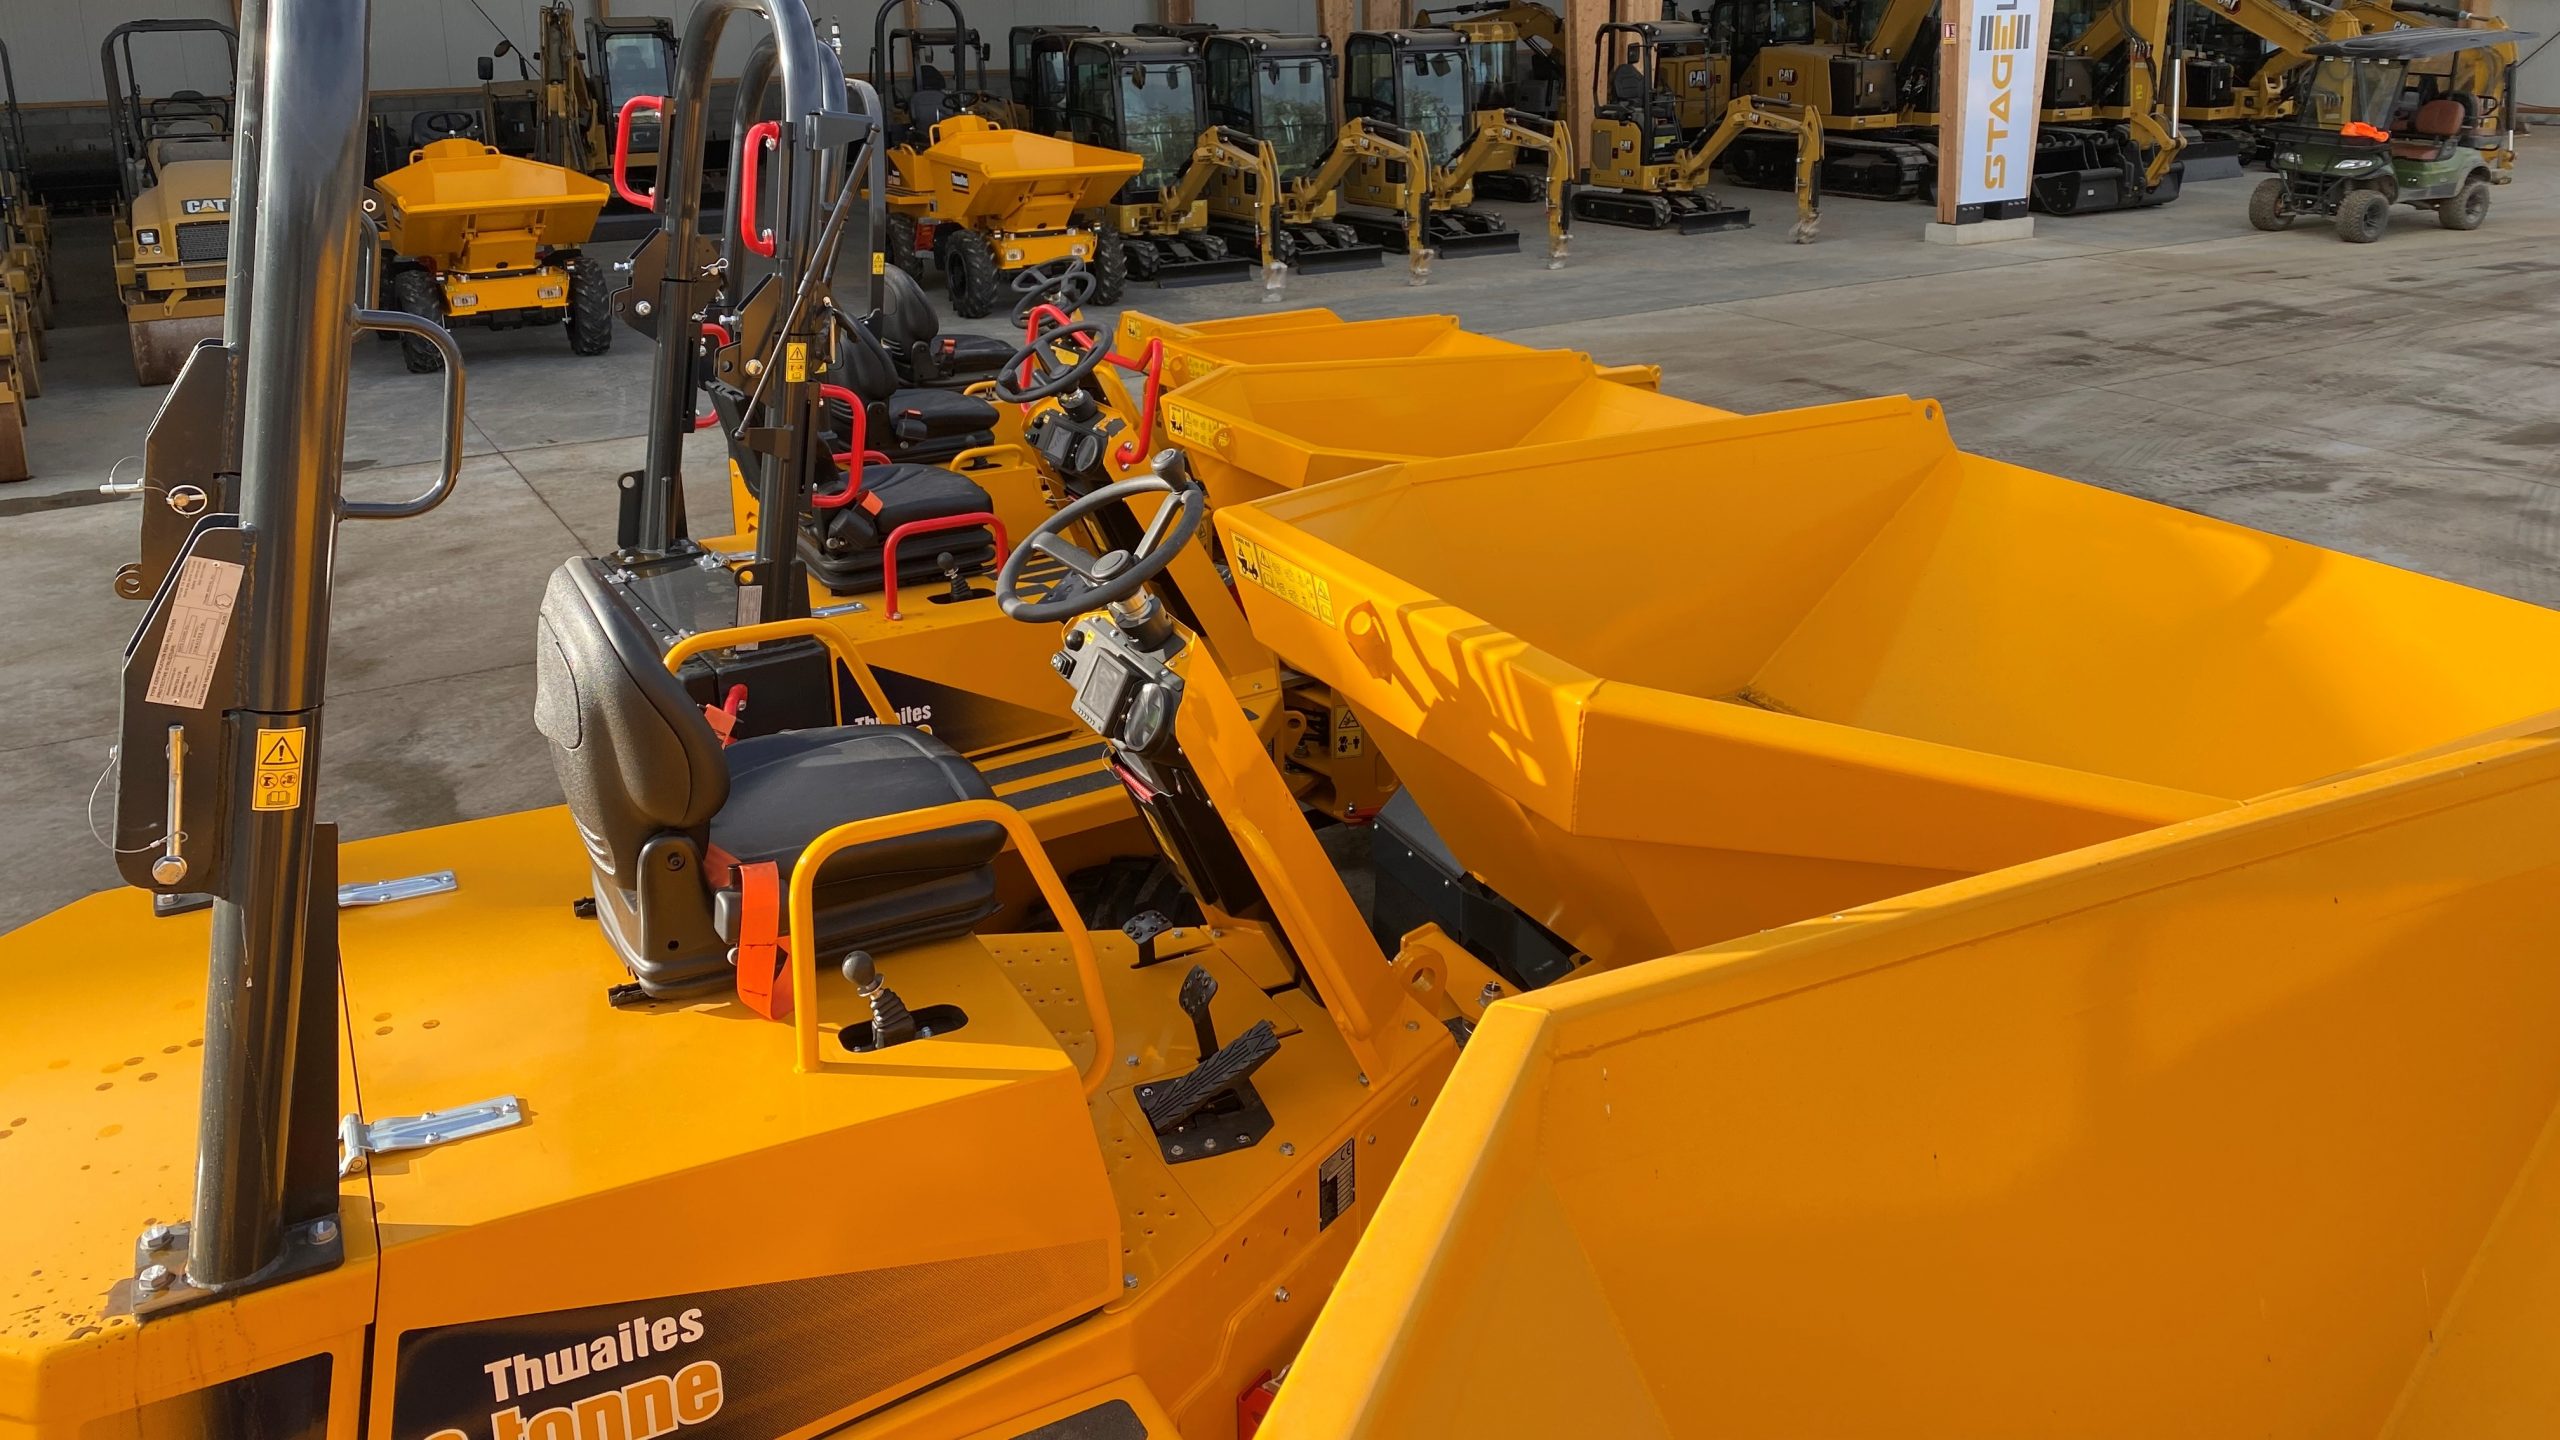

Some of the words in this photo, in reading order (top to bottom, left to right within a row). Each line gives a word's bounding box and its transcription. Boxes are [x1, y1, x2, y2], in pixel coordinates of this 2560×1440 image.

[1778, 68, 1795, 83] CAT
[1620, 140, 1631, 151] CAT
[186, 199, 227, 214] CAT
[854, 705, 932, 725] Thites
[484, 1308, 704, 1402] Thwaites
